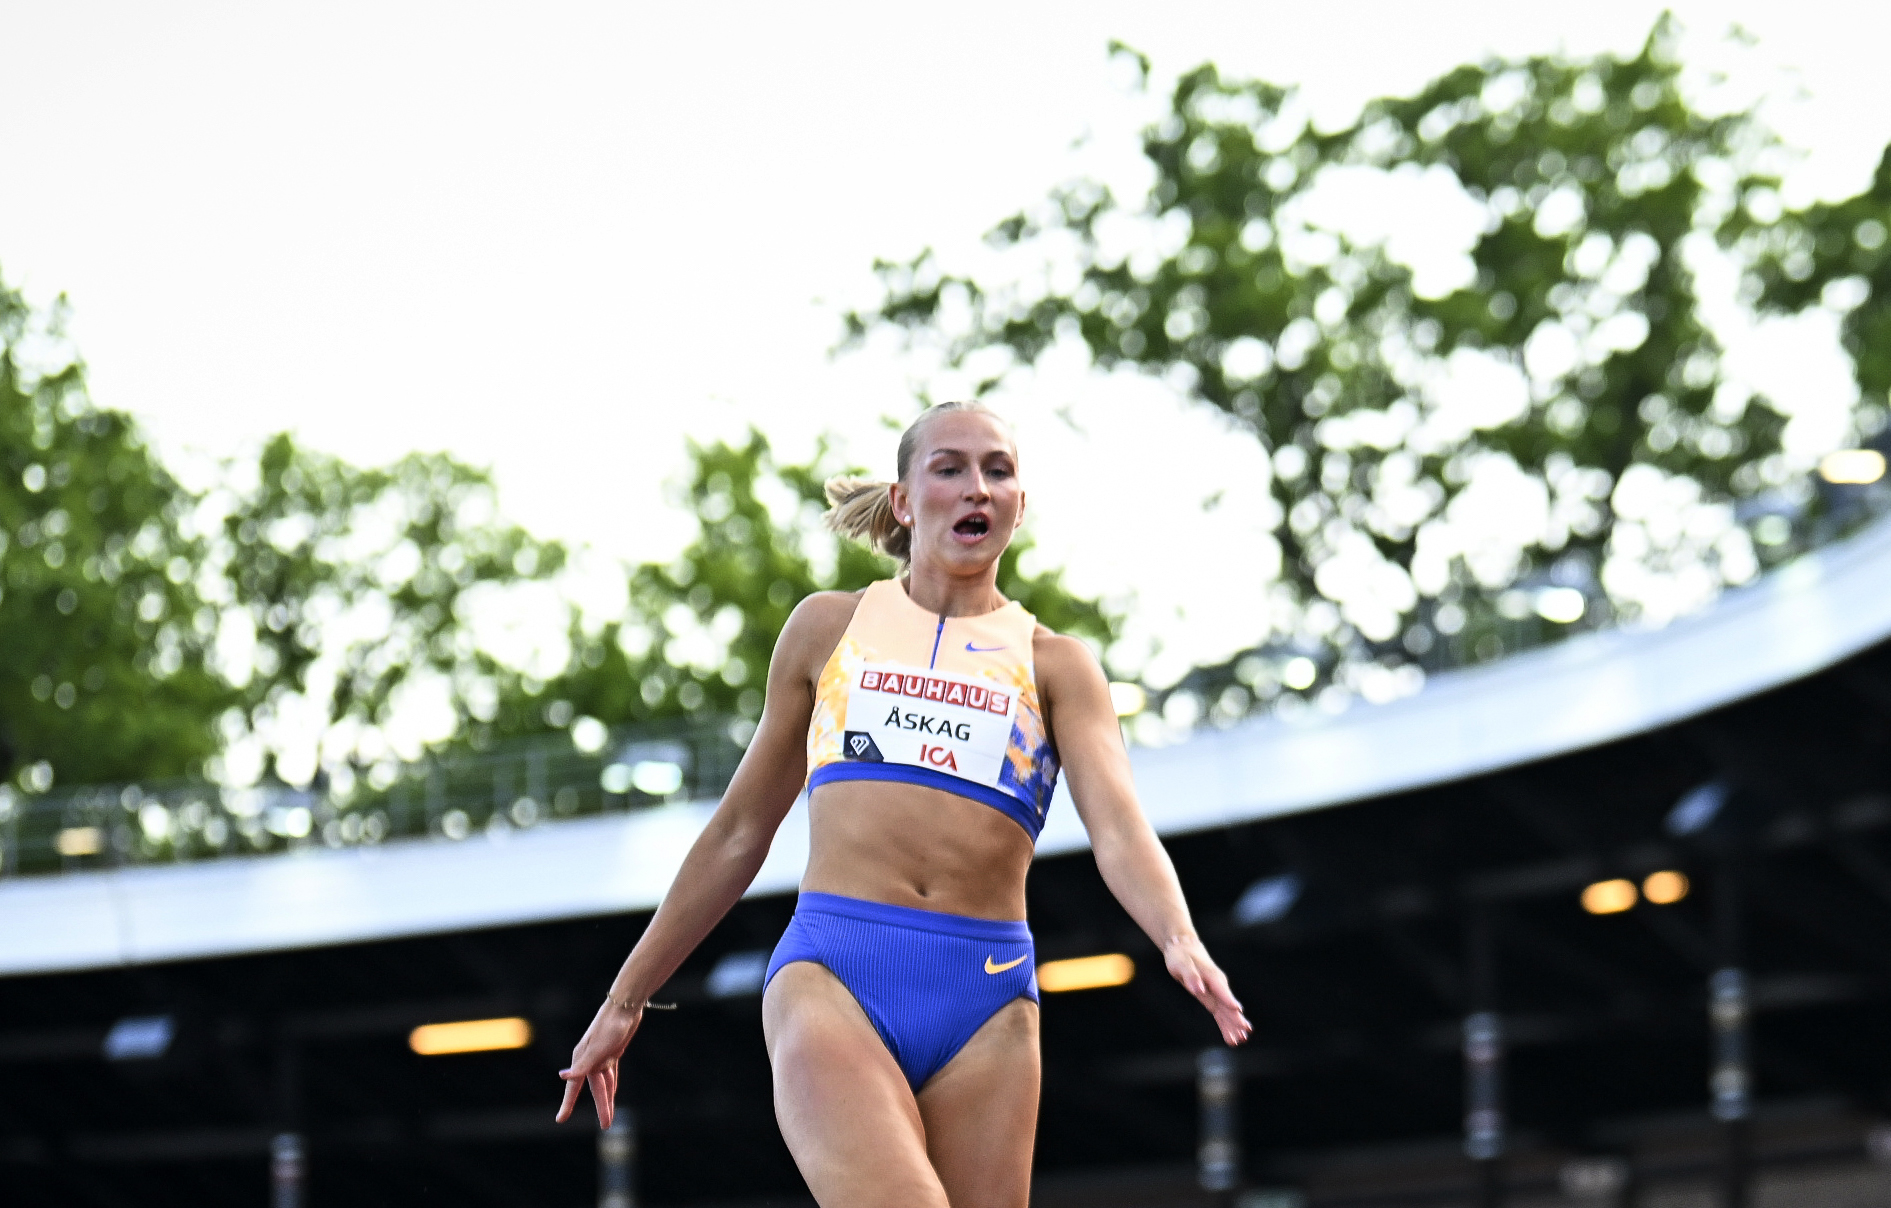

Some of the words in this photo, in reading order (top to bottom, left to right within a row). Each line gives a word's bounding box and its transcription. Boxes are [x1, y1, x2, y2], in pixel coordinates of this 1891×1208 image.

[861, 671, 1009, 715] BAUHAUS
[884, 706, 971, 741] ÅSKAG
[919, 744, 957, 772] ICA
